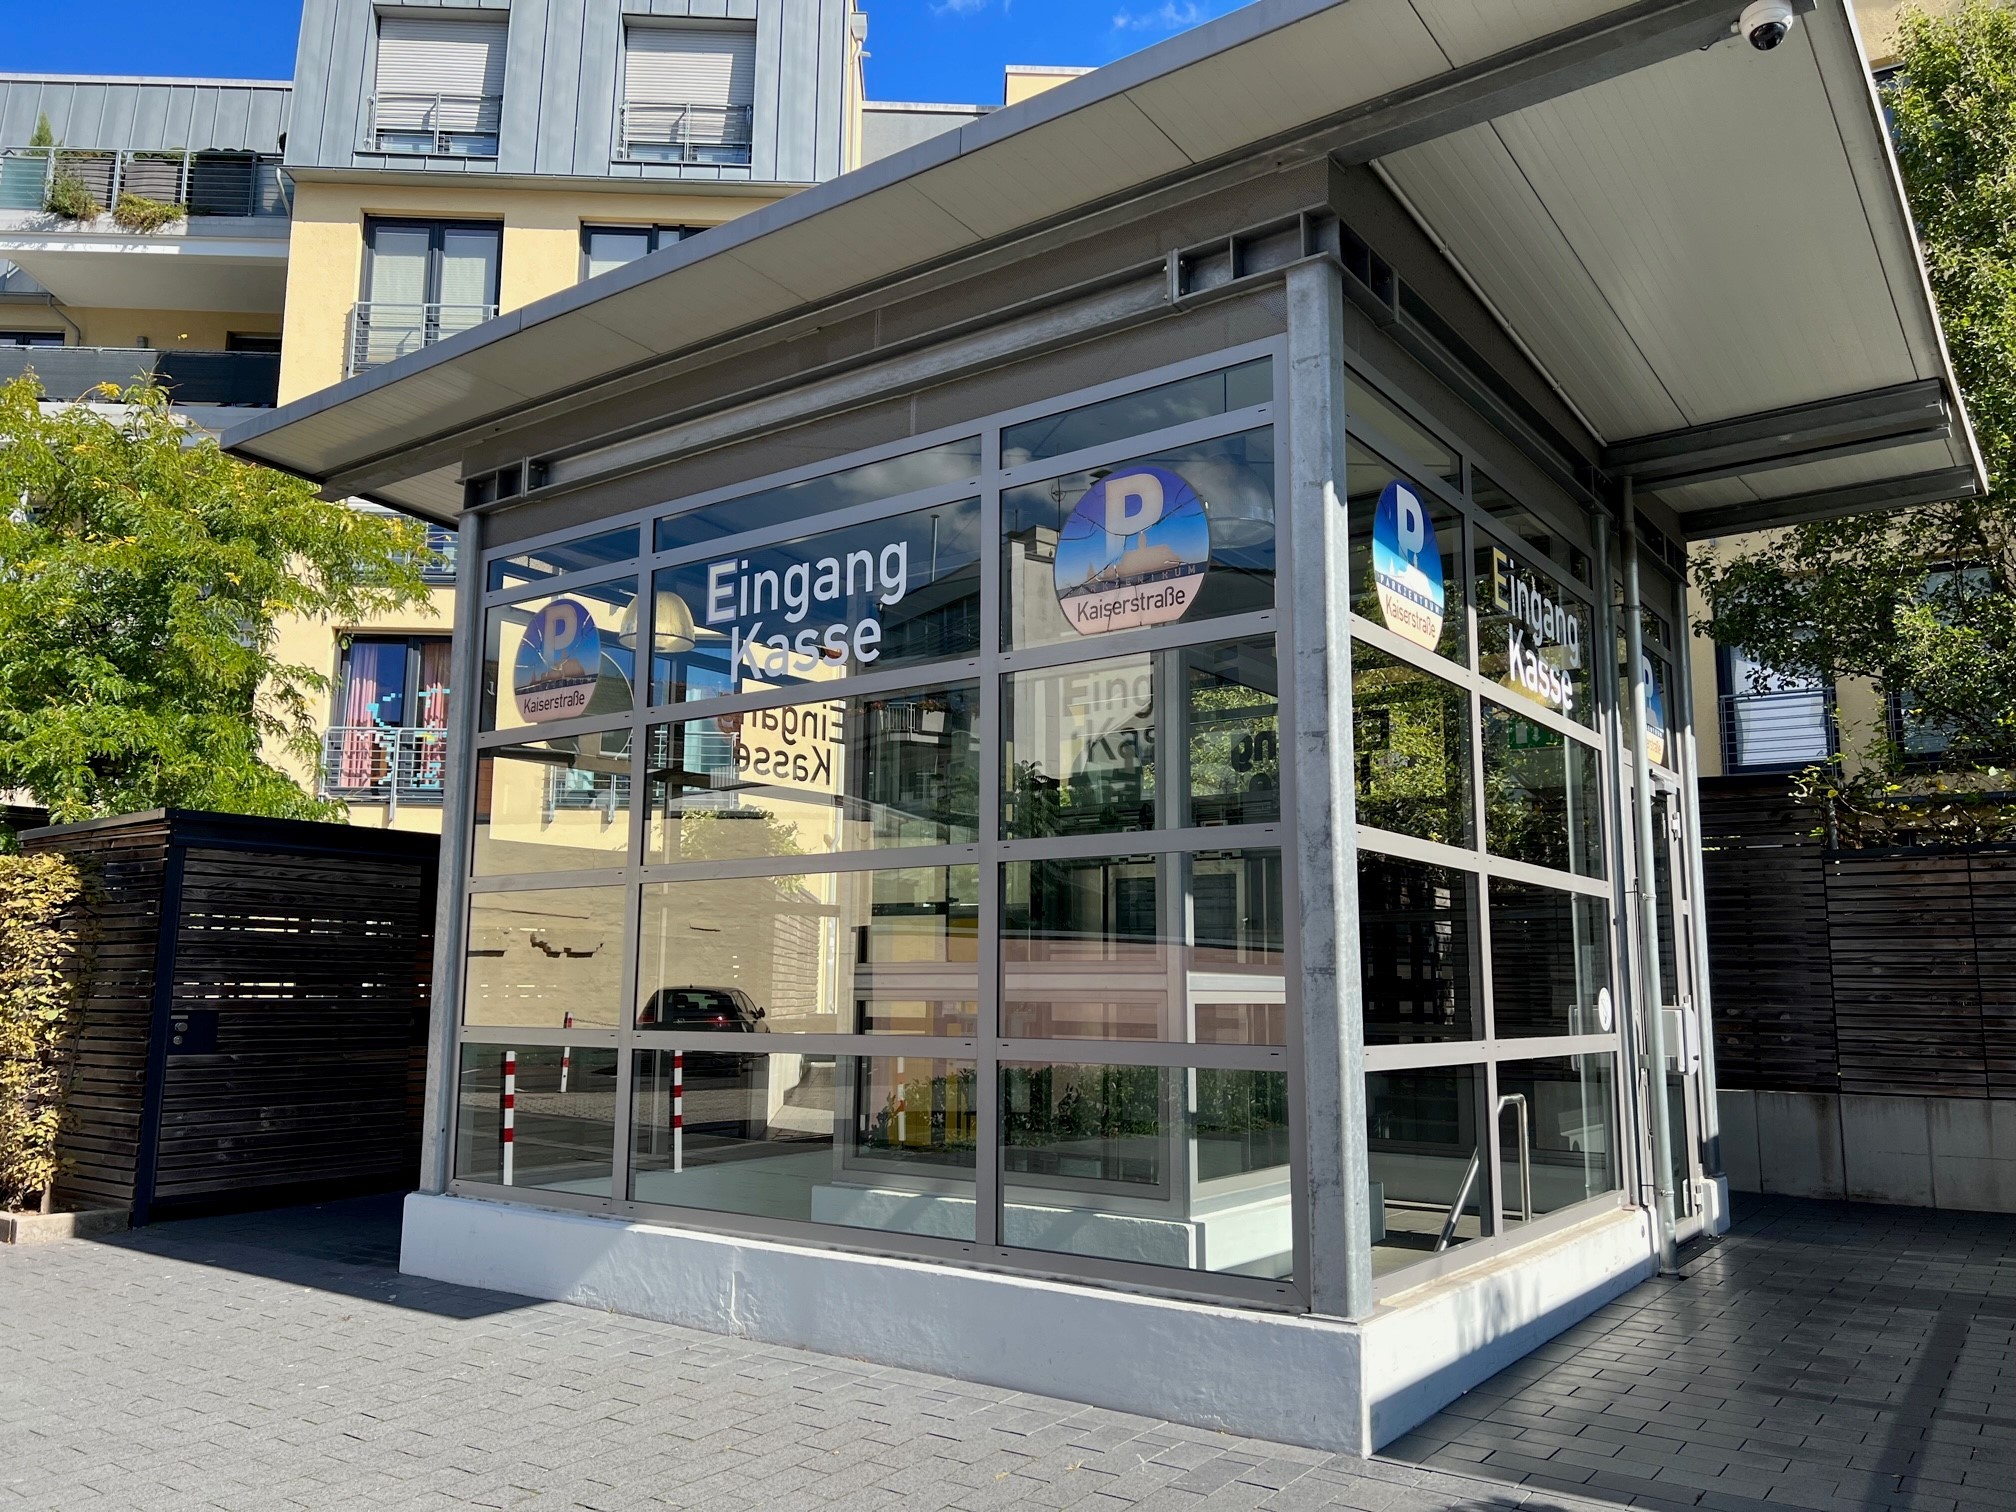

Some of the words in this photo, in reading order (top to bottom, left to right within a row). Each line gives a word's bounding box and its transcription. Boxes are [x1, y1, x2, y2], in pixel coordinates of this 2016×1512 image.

[1105, 472, 1164, 547] P
[1397, 483, 1425, 562] P
[706, 541, 907, 625] Eingang
[1068, 564, 1198, 597] ARKZENTRUM
[1077, 586, 1186, 623] Kaiserstraße
[1493, 547, 1580, 669] Eingang
[543, 603, 577, 655] P
[1385, 593, 1436, 638] Kaiserstraße
[731, 617, 882, 683] Kasse
[1509, 622, 1573, 710] Kasse
[523, 690, 585, 714] Kaiserstraße
[1064, 672, 1154, 719] Eing
